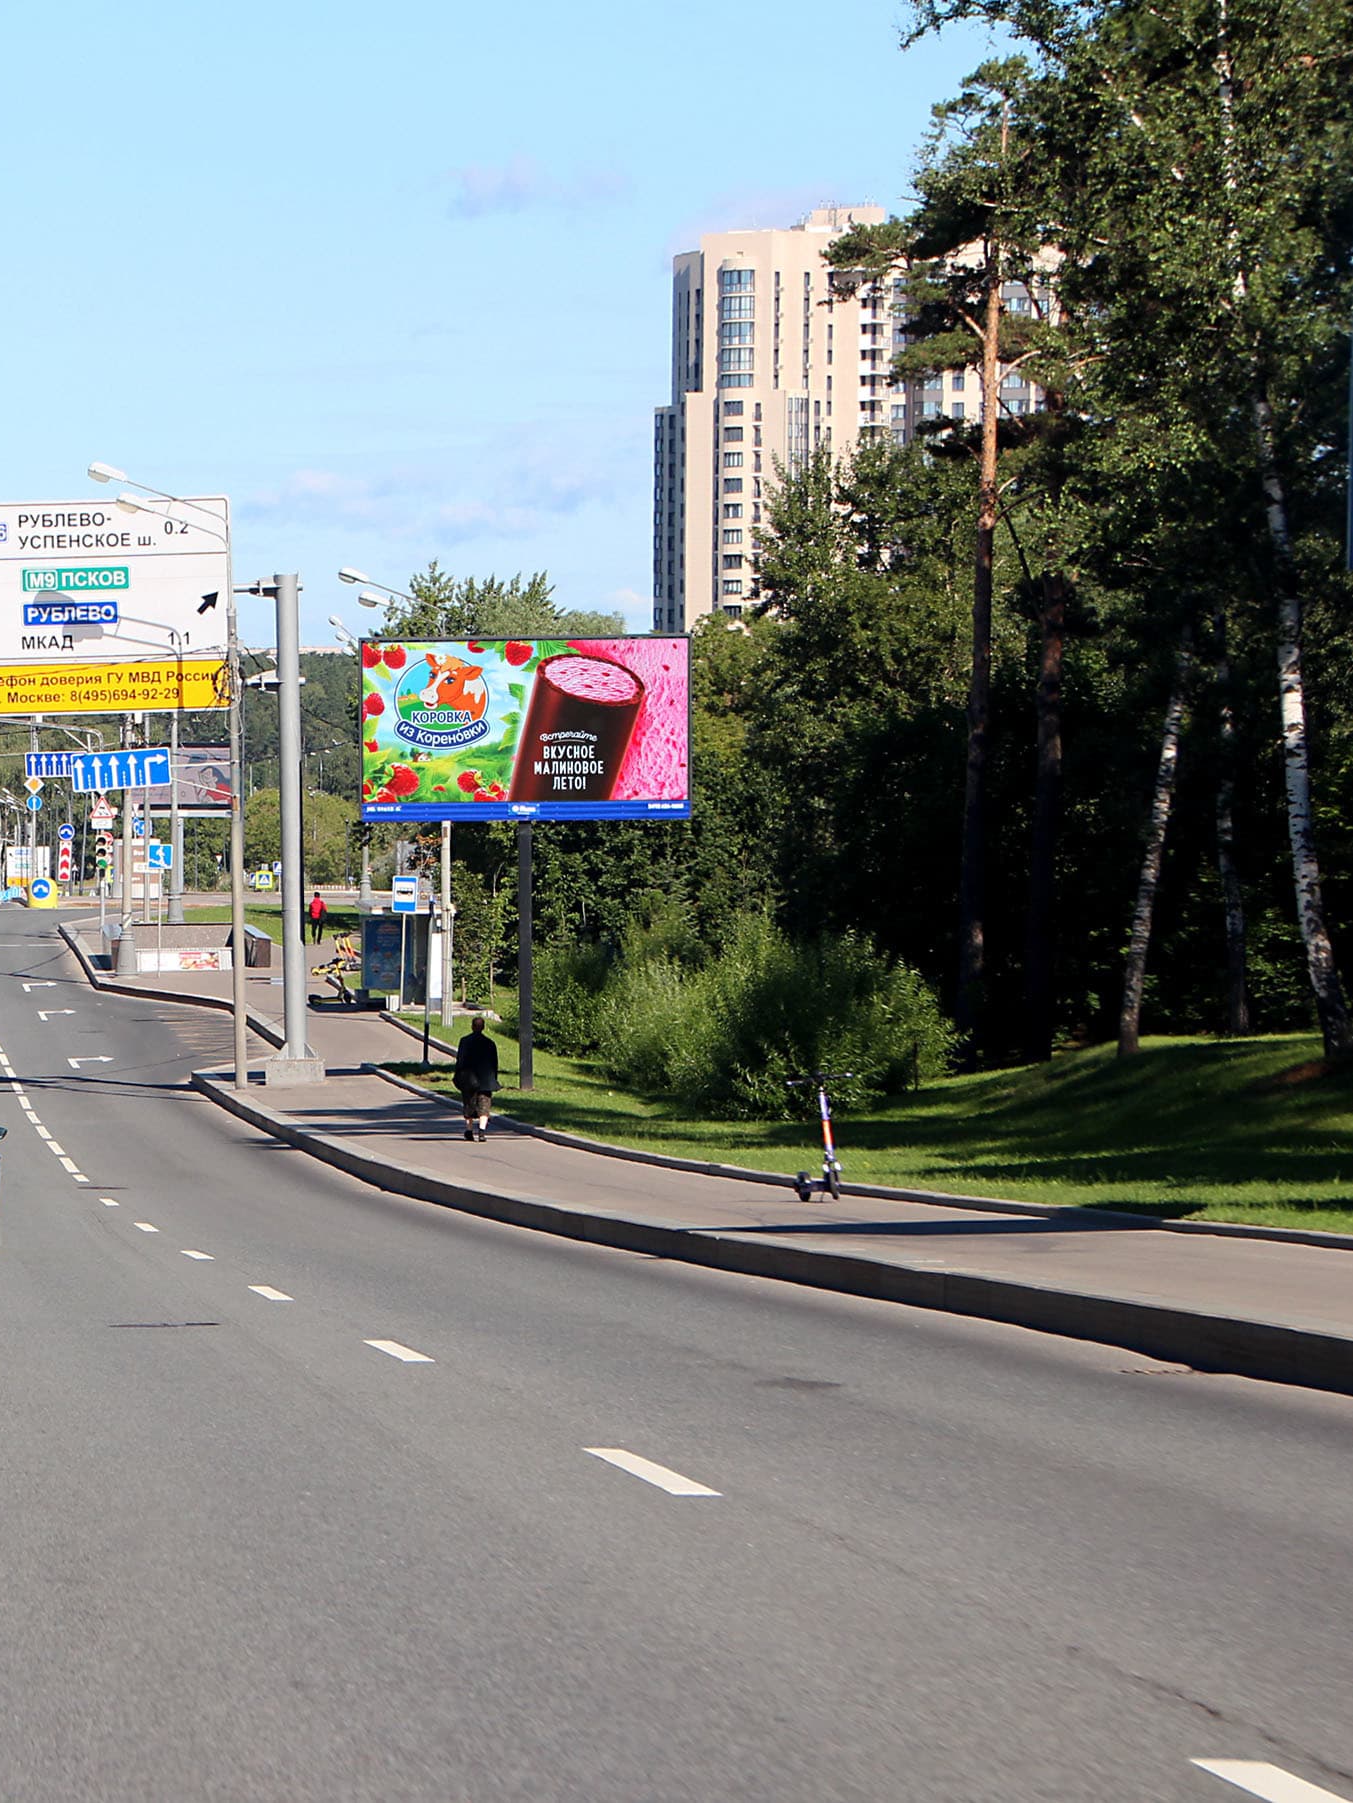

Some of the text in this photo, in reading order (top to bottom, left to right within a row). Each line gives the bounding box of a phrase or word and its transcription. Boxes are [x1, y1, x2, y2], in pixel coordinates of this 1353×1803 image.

[17, 512, 112, 529] РУБЛЕВО-
[17, 532, 131, 550] УСПЕНСКОЕ
[29, 570, 126, 589] М9 ПСКОВ
[27, 605, 116, 622] РУБЛЕВО
[21, 635, 74, 651] МКАД
[39, 675, 102, 688] доверия
[107, 672, 124, 684] ГУ
[128, 671, 162, 685] МВД
[7, 691, 65, 704] Москве:
[70, 688, 180, 705] 8(495)694-92-29
[412, 711, 472, 723] КОРОВКА
[543, 745, 595, 759] ВКУСНОЕ
[533, 760, 604, 775] МАЛИНОВОЕ
[552, 776, 587, 790] ЛЕТО!
